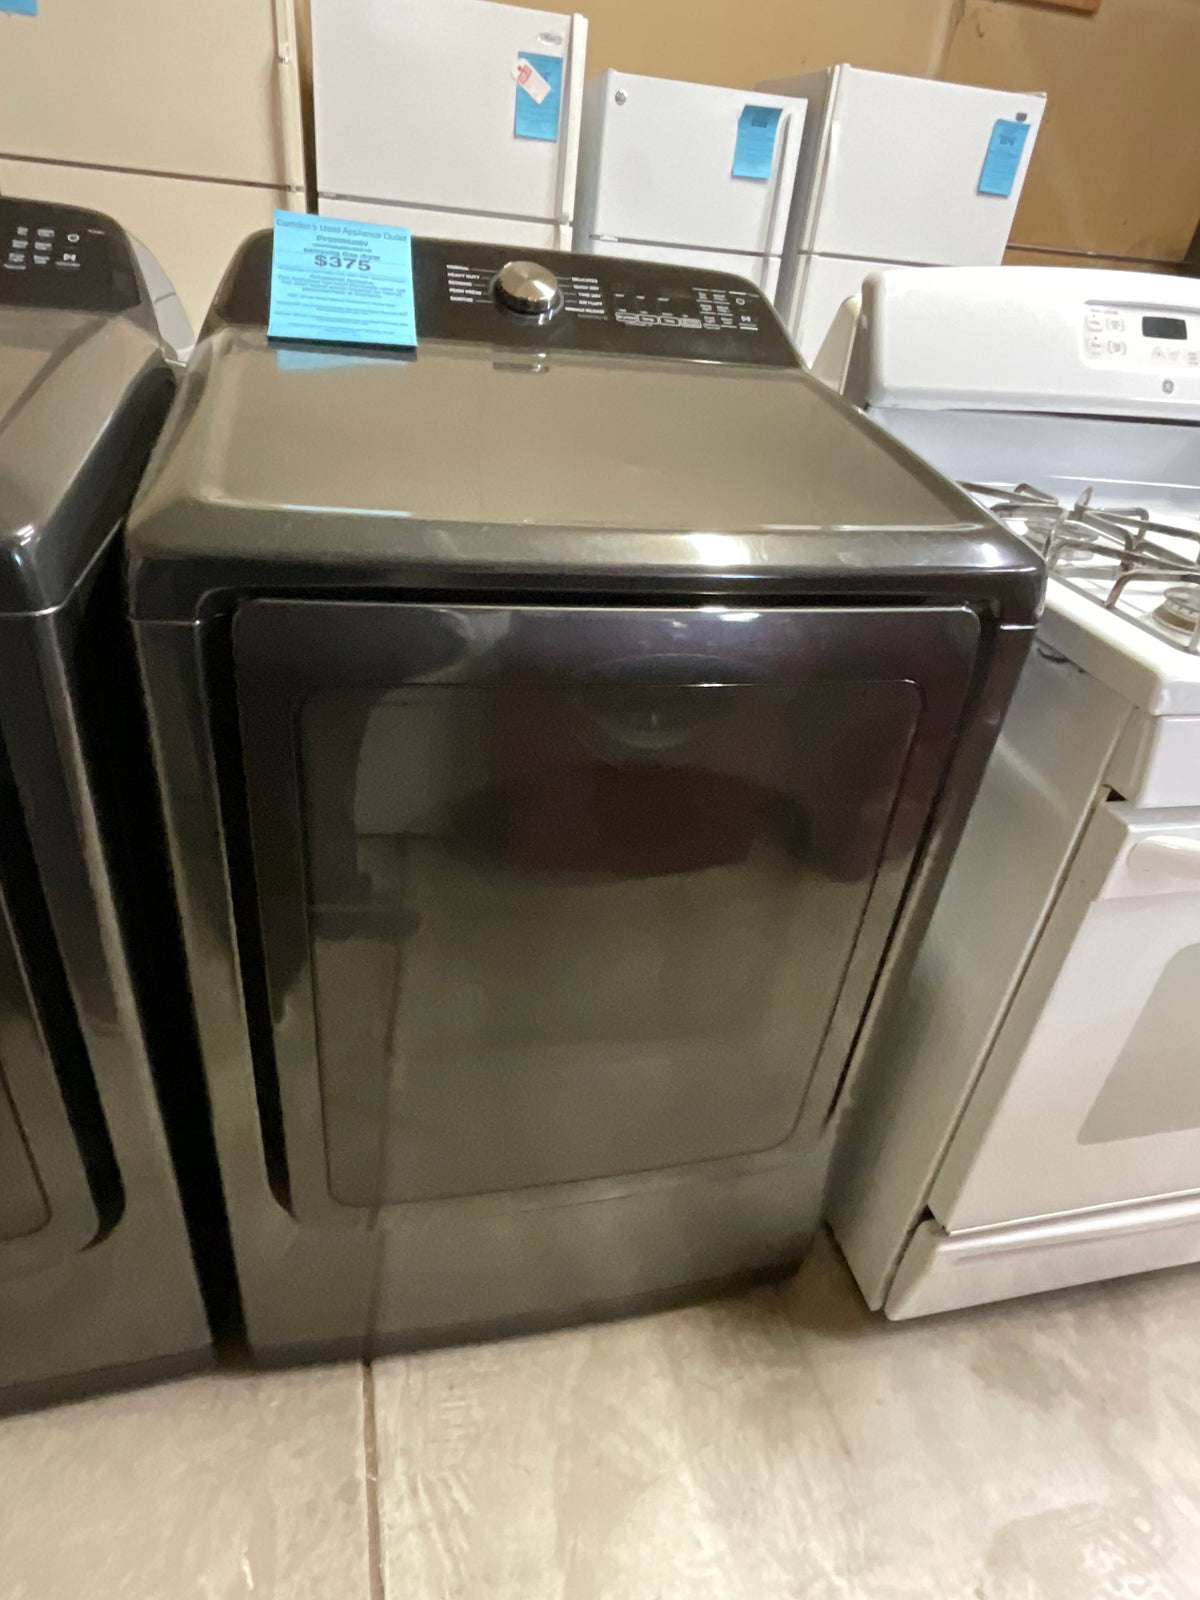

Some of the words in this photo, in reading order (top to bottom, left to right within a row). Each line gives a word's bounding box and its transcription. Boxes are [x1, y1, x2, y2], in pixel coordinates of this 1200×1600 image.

[320, 224, 341, 233] Used
[343, 226, 381, 238] Appliance
[384, 232, 407, 242] Outlet
[314, 255, 371, 272] $375
